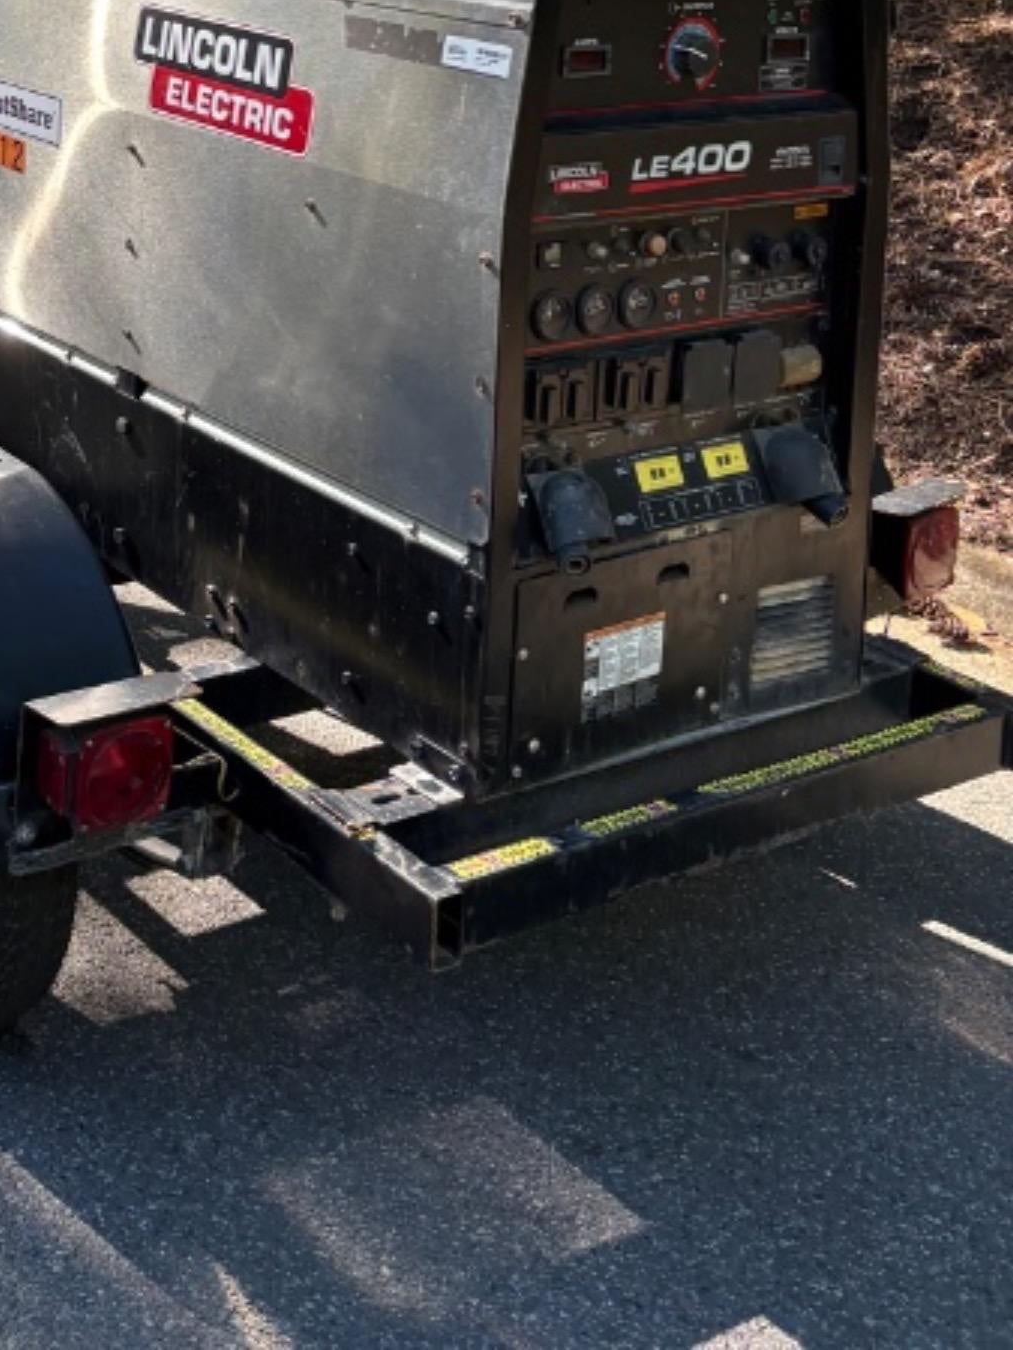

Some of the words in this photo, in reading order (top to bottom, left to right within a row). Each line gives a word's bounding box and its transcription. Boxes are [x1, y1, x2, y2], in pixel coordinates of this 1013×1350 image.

[141, 16, 285, 91] LINCOLN
[165, 75, 295, 140] ELECTRIC
[631, 140, 753, 182] LE400
